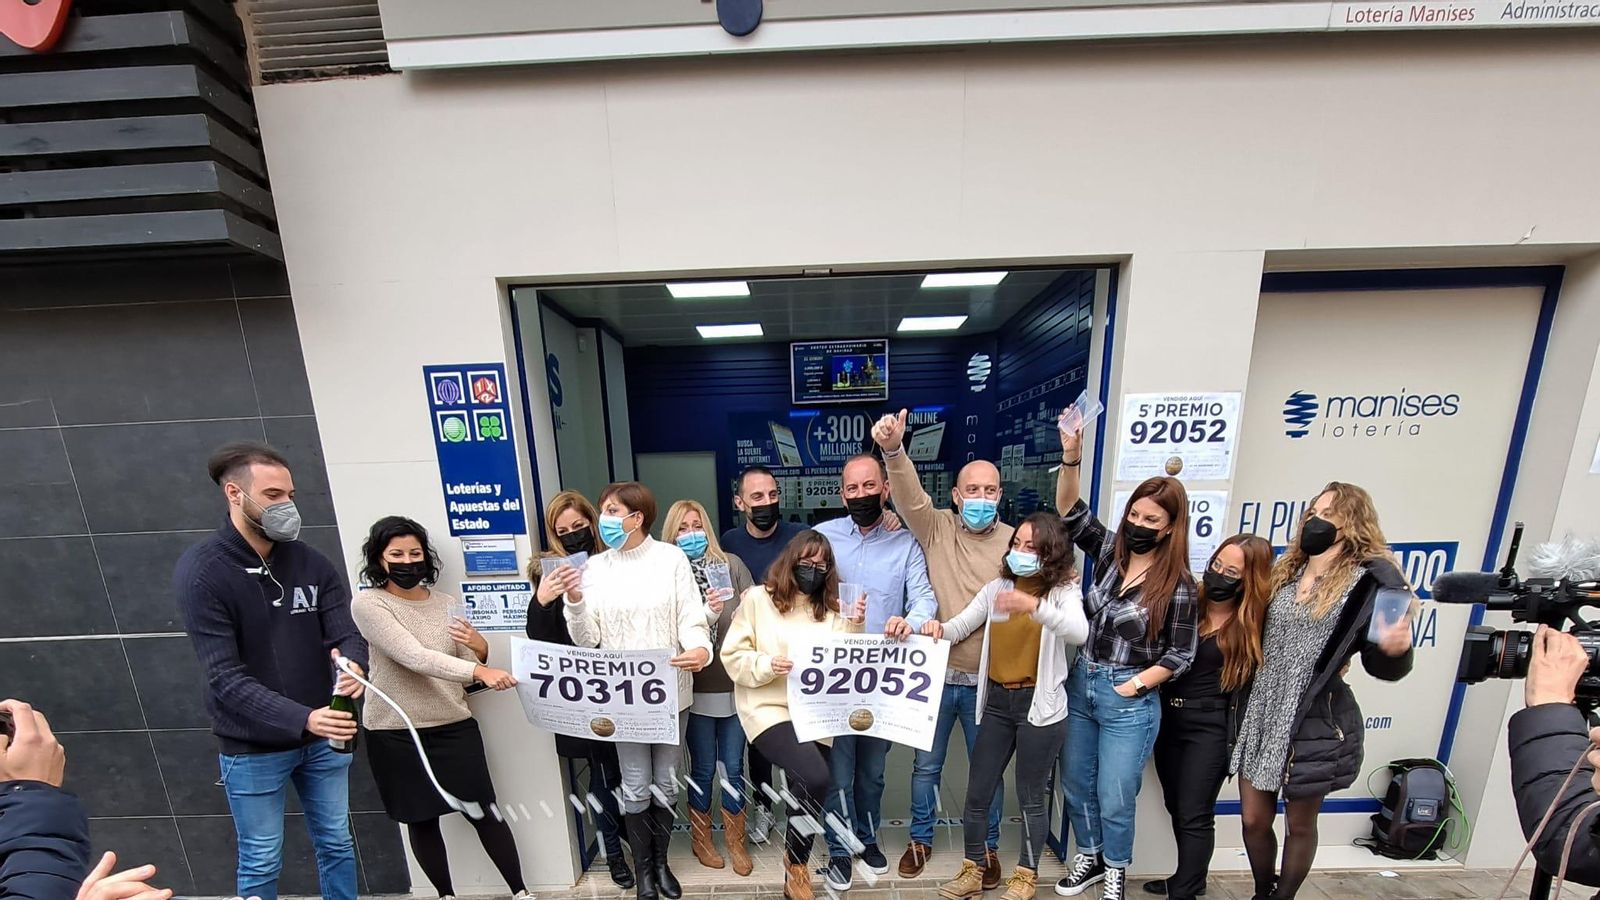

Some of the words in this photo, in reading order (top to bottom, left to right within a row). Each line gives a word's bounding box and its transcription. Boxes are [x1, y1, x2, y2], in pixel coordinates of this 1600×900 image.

[1345, 6, 1403, 24] Lotería
[1409, 4, 1475, 23] Manises
[1155, 403, 1223, 417] PREMIO
[1326, 388, 1460, 418] manises
[908, 412, 938, 424] ONLINE
[813, 415, 865, 442] +300
[1130, 419, 1227, 444] 92052
[1322, 421, 1421, 438] lotería
[820, 443, 863, 455] MILLONES
[737, 456, 748, 464] POR
[446, 482, 492, 495] Loterías
[495, 484, 502, 496] y
[806, 487, 840, 496] 92052
[450, 501, 500, 515] Apuestas
[503, 499, 520, 512] del
[452, 518, 490, 530] Estado
[467, 584, 492, 592] AFORO
[293, 585, 318, 609] AY
[465, 595, 476, 609] 5
[500, 594, 508, 608] 1
[566, 650, 601, 659] VENDIDO
[603, 651, 623, 660] AQUÍ
[811, 647, 829, 664] 5º
[834, 647, 927, 667] PREMIO
[538, 654, 554, 670] 5º
[559, 657, 656, 676] PREMIO
[530, 673, 667, 705] 70316
[800, 667, 932, 703] 92052
